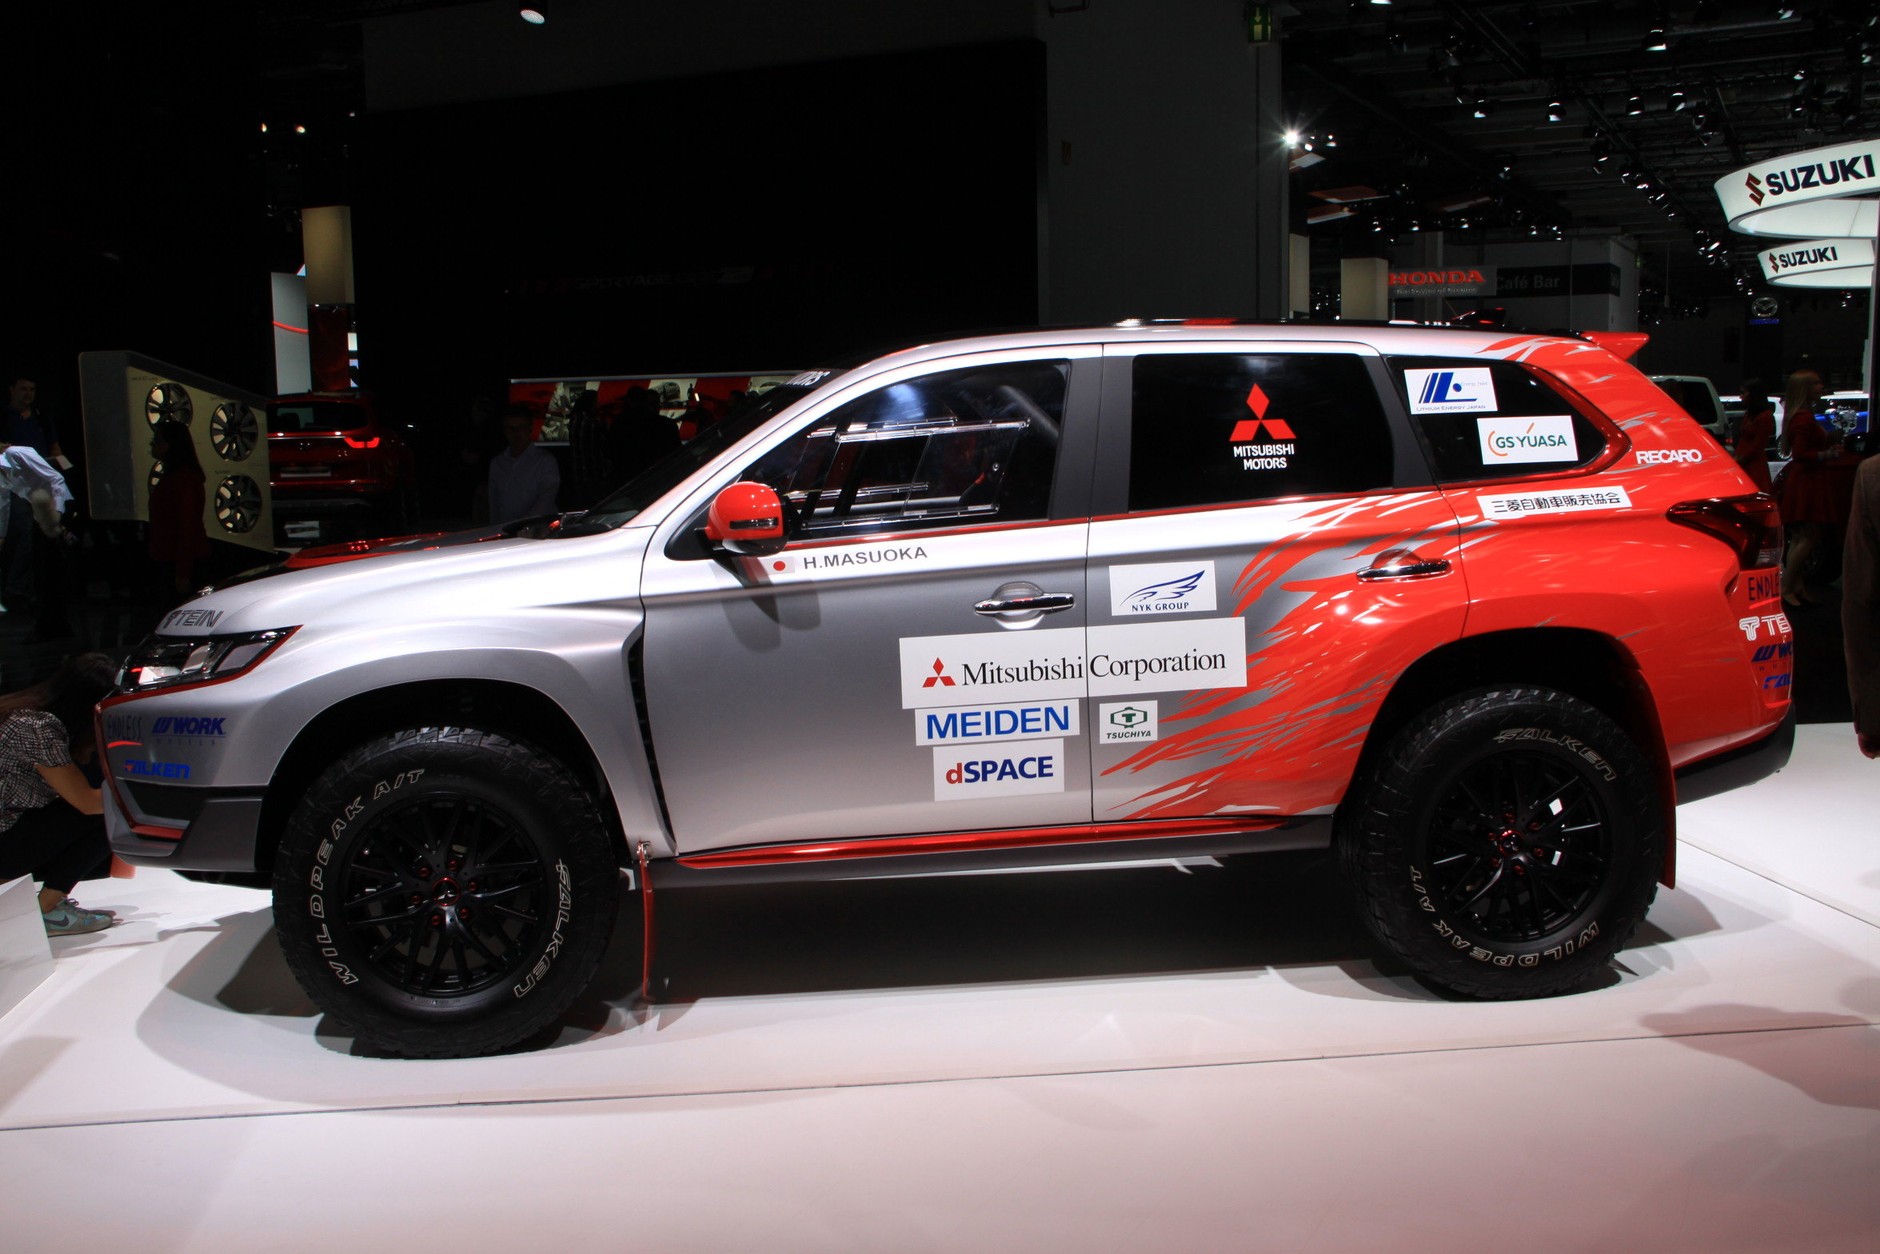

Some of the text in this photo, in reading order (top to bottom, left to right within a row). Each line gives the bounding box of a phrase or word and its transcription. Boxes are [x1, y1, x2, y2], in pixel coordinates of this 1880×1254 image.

[1765, 154, 1876, 196] SUZUKI
[1779, 246, 1838, 268] SUZUKI
[1388, 269, 1486, 286] HONDA
[1533, 274, 1561, 289] Bar
[1233, 443, 1295, 458] MITSUBISHI
[1495, 434, 1567, 449] GS YUASA
[1243, 457, 1287, 471] MOTORS
[1635, 449, 1702, 465] RECARO
[1491, 492, 1621, 514] 三菱自動車販売協会
[803, 546, 928, 570] H.MASUOKA
[1131, 601, 1190, 613] NYK GROUP
[961, 648, 1227, 686] Mitsubishi Corporation
[108, 715, 143, 740] ENDLESS
[173, 717, 226, 735] WORK
[926, 705, 1070, 740] MEIDEN
[1106, 730, 1152, 740] TSUCHIYA
[1492, 728, 1617, 782] FALKEN
[124, 759, 191, 779] FALKEN
[945, 756, 1054, 785] dSPACE
[310, 797, 364, 985] WILDPEAK
[513, 858, 572, 998] FALKEN
[1432, 920, 1600, 967] WILDPEAK
